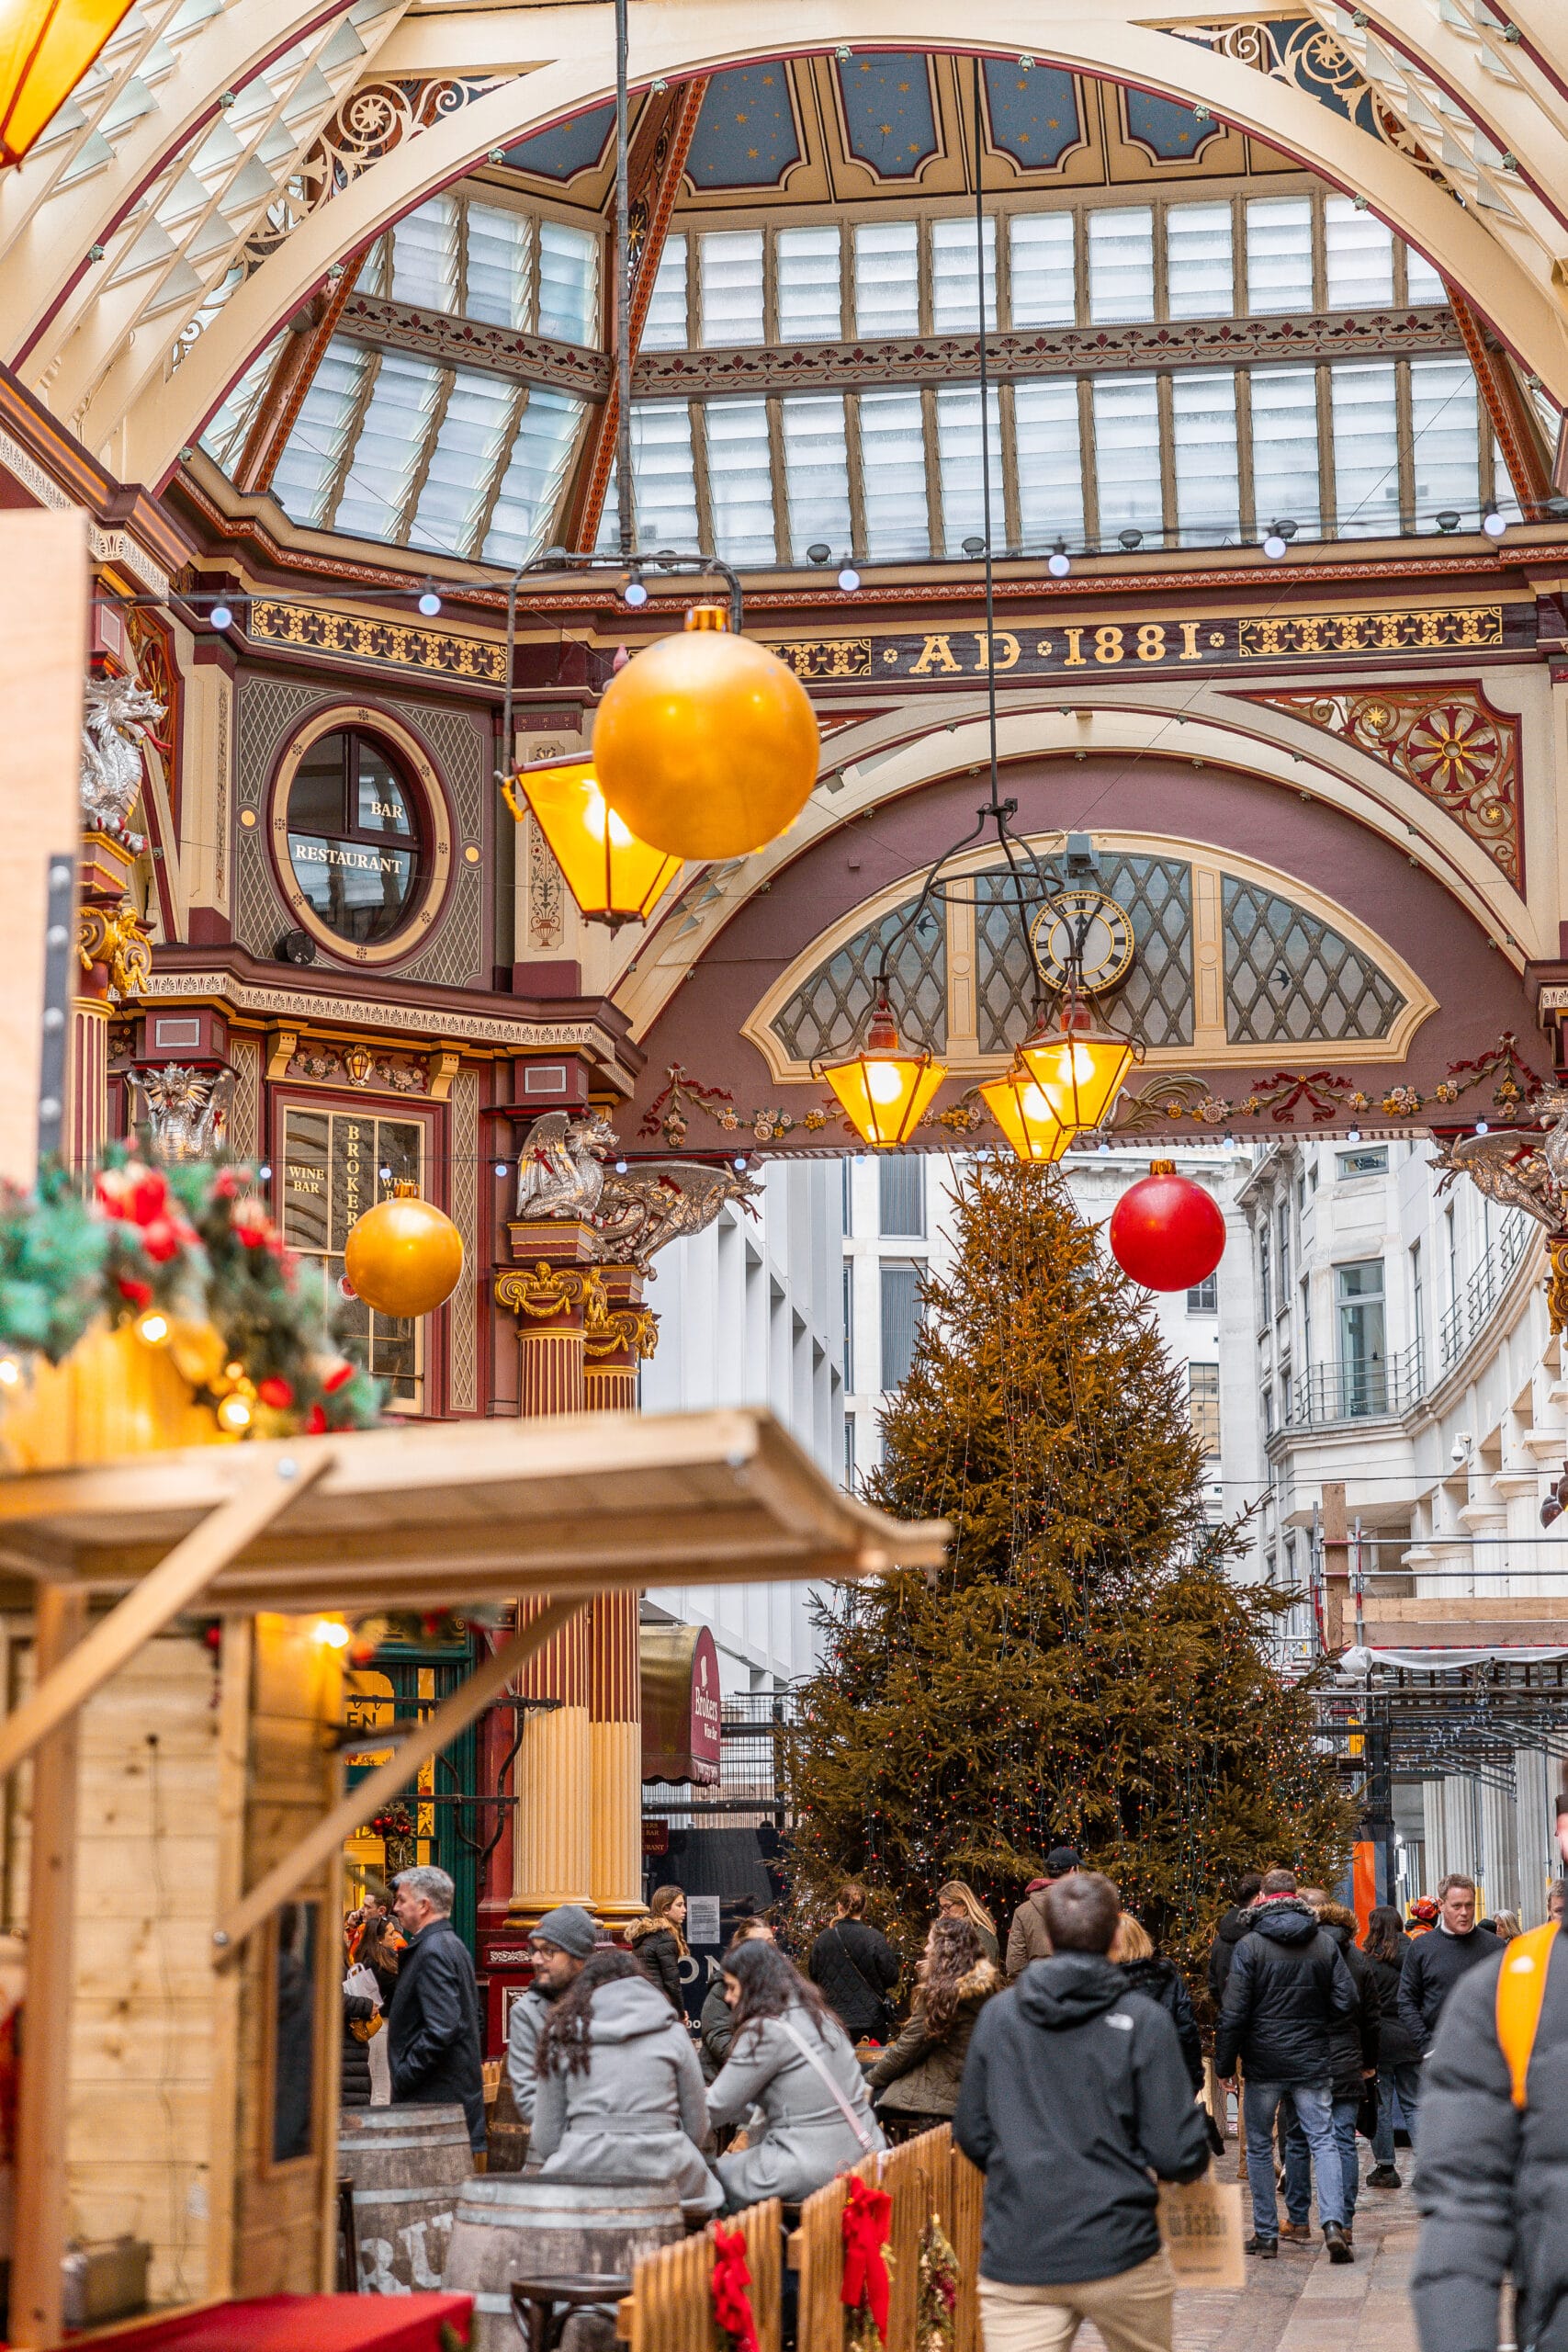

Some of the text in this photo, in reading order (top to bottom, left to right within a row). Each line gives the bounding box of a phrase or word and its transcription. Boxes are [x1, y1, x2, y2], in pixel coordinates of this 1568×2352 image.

[1064, 623, 1202, 666] 1881
[371, 801, 403, 820] BAR
[295, 844, 403, 874] RESTAURANT
[288, 1166, 325, 1181] WINE
[293, 1180, 320, 1193] BAR
[346, 1125, 361, 1236] BROKER
[694, 1686, 718, 1723] Brokers
